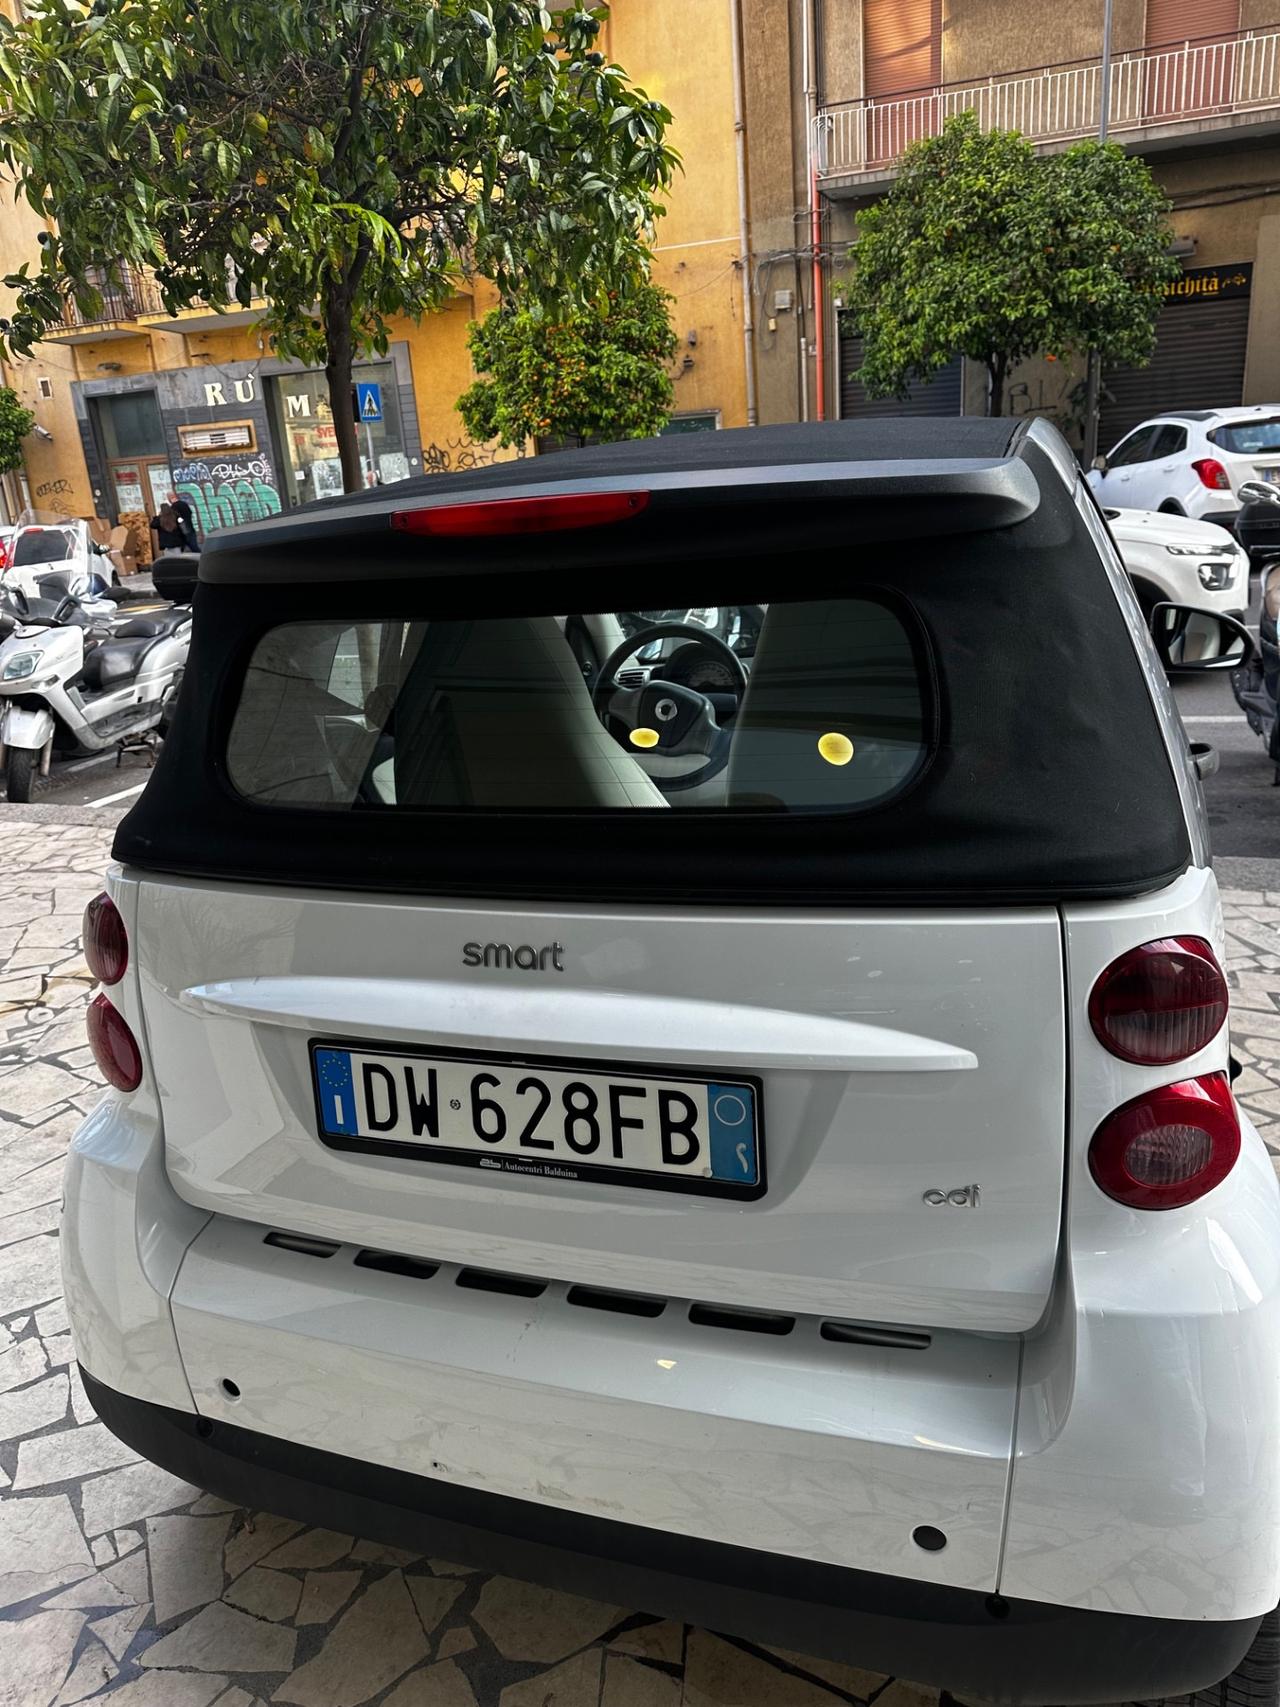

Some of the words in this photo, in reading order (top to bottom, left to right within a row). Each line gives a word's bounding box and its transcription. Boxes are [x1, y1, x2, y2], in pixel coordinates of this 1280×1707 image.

[462, 941, 564, 972] smart
[504, 1161, 543, 1175] Autocentri
[544, 1165, 578, 1179] Balduina
[922, 1184, 982, 1208] cdi
